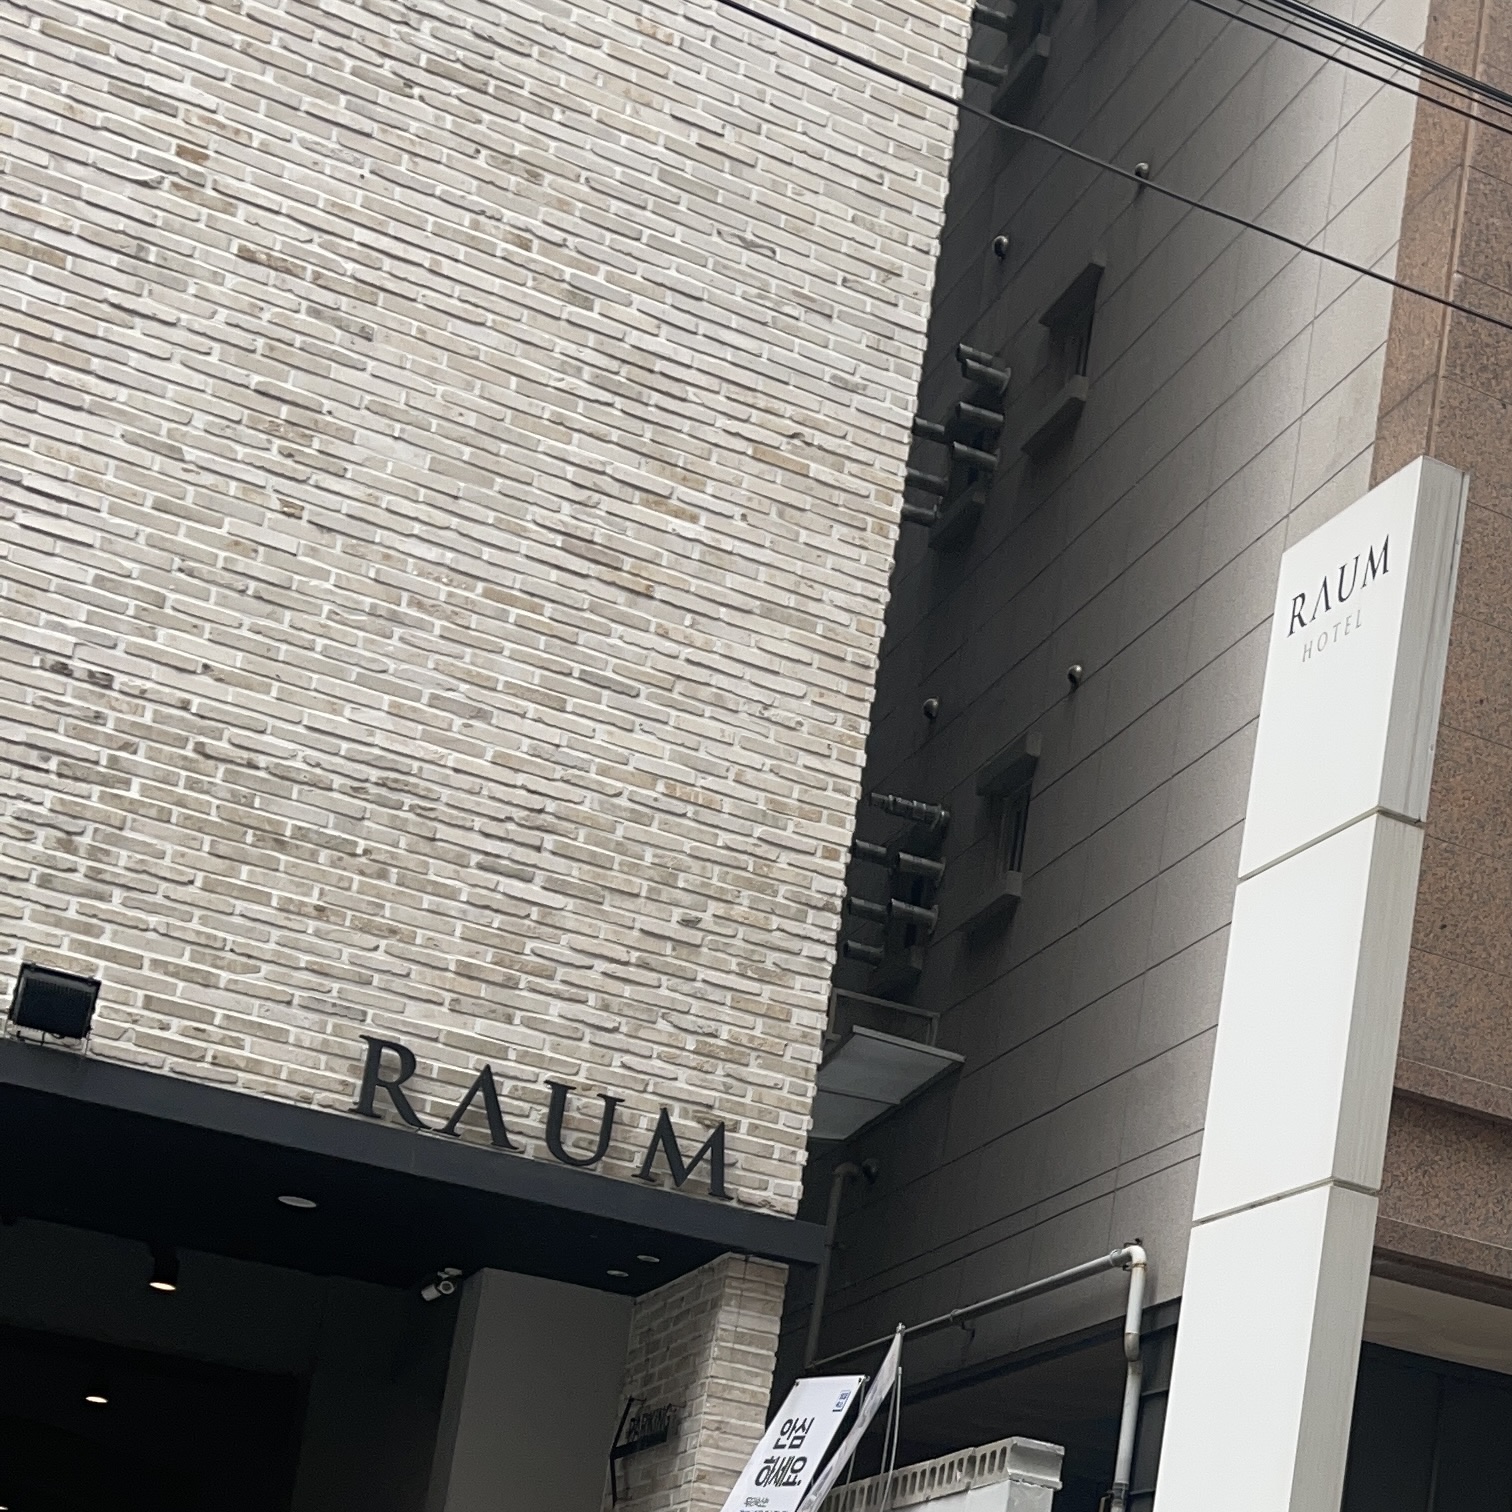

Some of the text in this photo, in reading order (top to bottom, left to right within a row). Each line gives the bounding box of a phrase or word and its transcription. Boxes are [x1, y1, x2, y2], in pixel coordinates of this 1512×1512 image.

[1287, 533, 1390, 639] RAUM
[1302, 609, 1362, 663] HOTEL
[347, 1034, 734, 1201] RAUM
[773, 1416, 816, 1450] 안심
